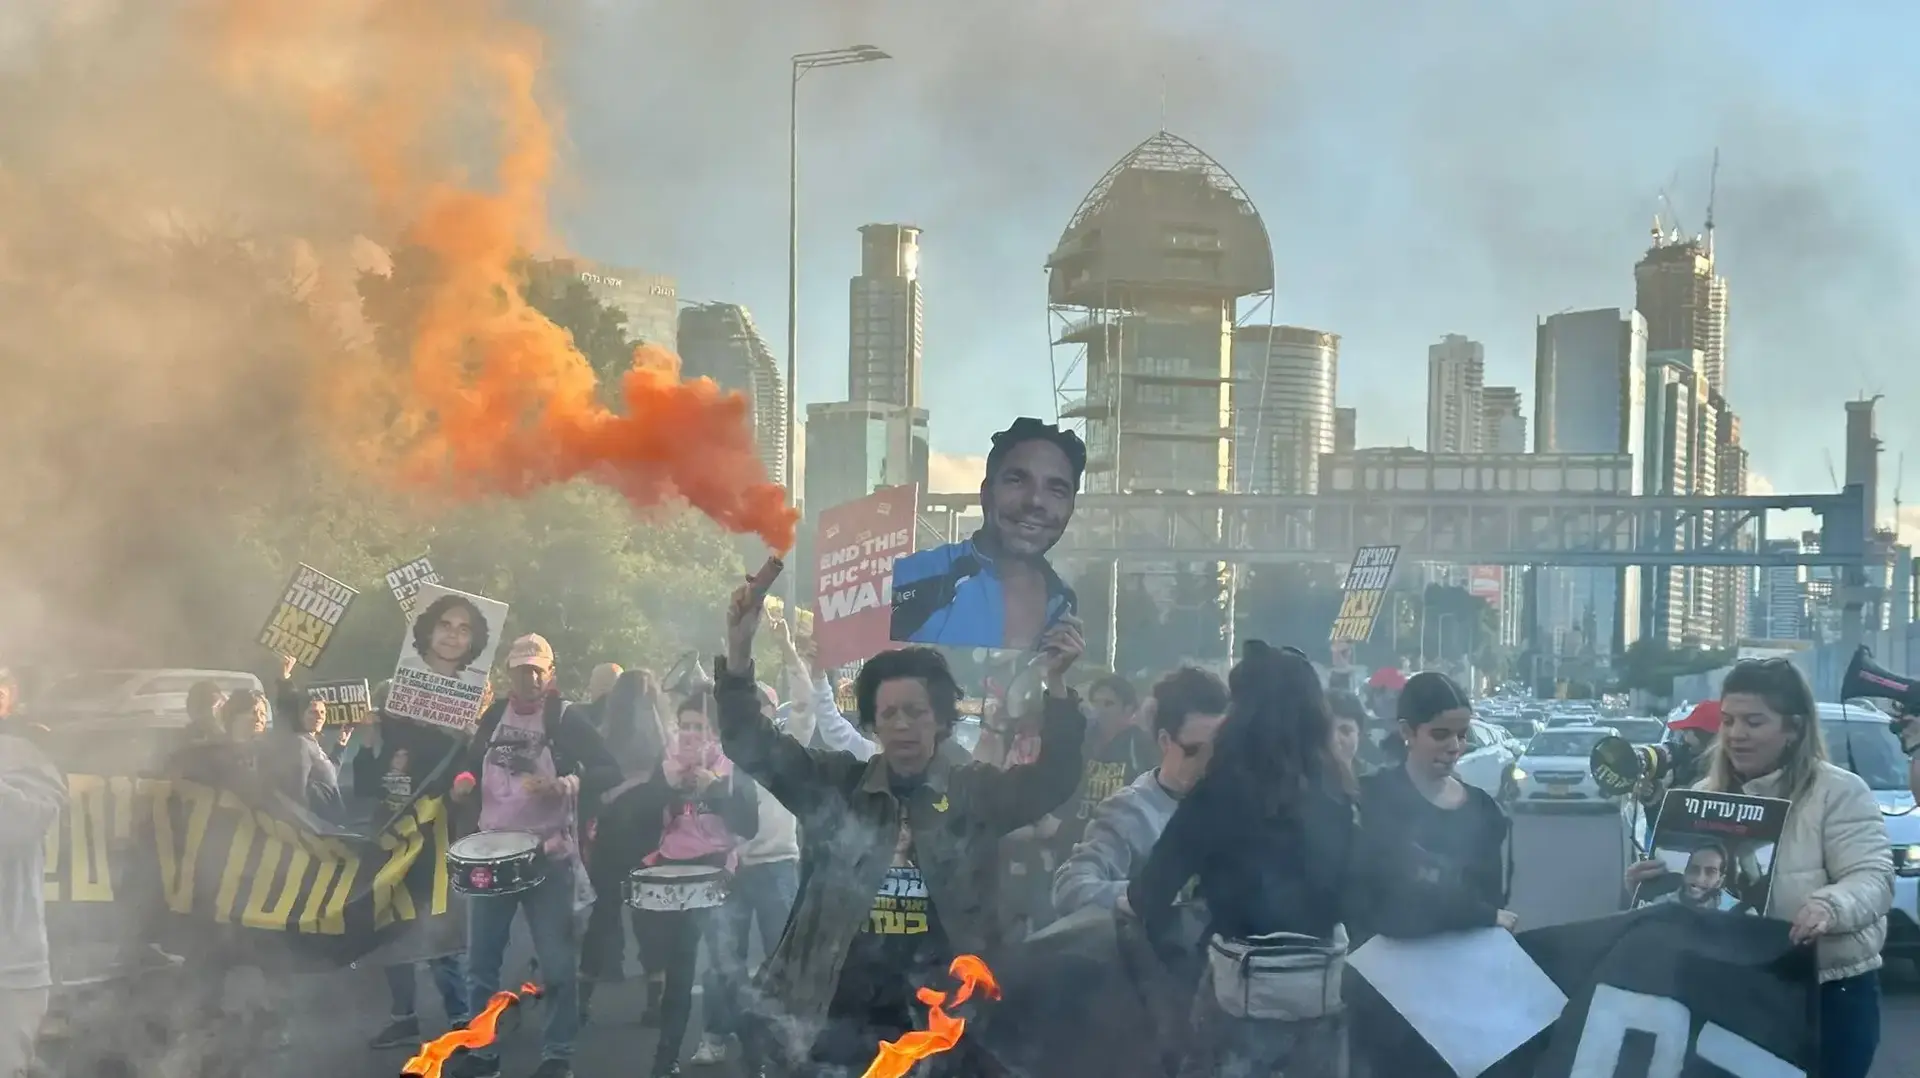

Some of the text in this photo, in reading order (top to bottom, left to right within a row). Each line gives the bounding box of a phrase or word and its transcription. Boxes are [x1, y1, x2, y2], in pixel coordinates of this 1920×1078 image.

[820, 544, 860, 571] END
[862, 528, 909, 556] THIS
[297, 567, 354, 607] תוציאו
[284, 583, 344, 626] מעזה
[272, 602, 333, 648] וצאו
[398, 667, 410, 677] MY
[411, 669, 428, 681] LIFE
[441, 677, 456, 688] THE
[340, 685, 366, 703] אתם
[392, 692, 476, 719] THEY ARE SIGNING MY
[388, 701, 420, 716] DEATH
[1685, 798, 1765, 822] מתן עדיין חי
